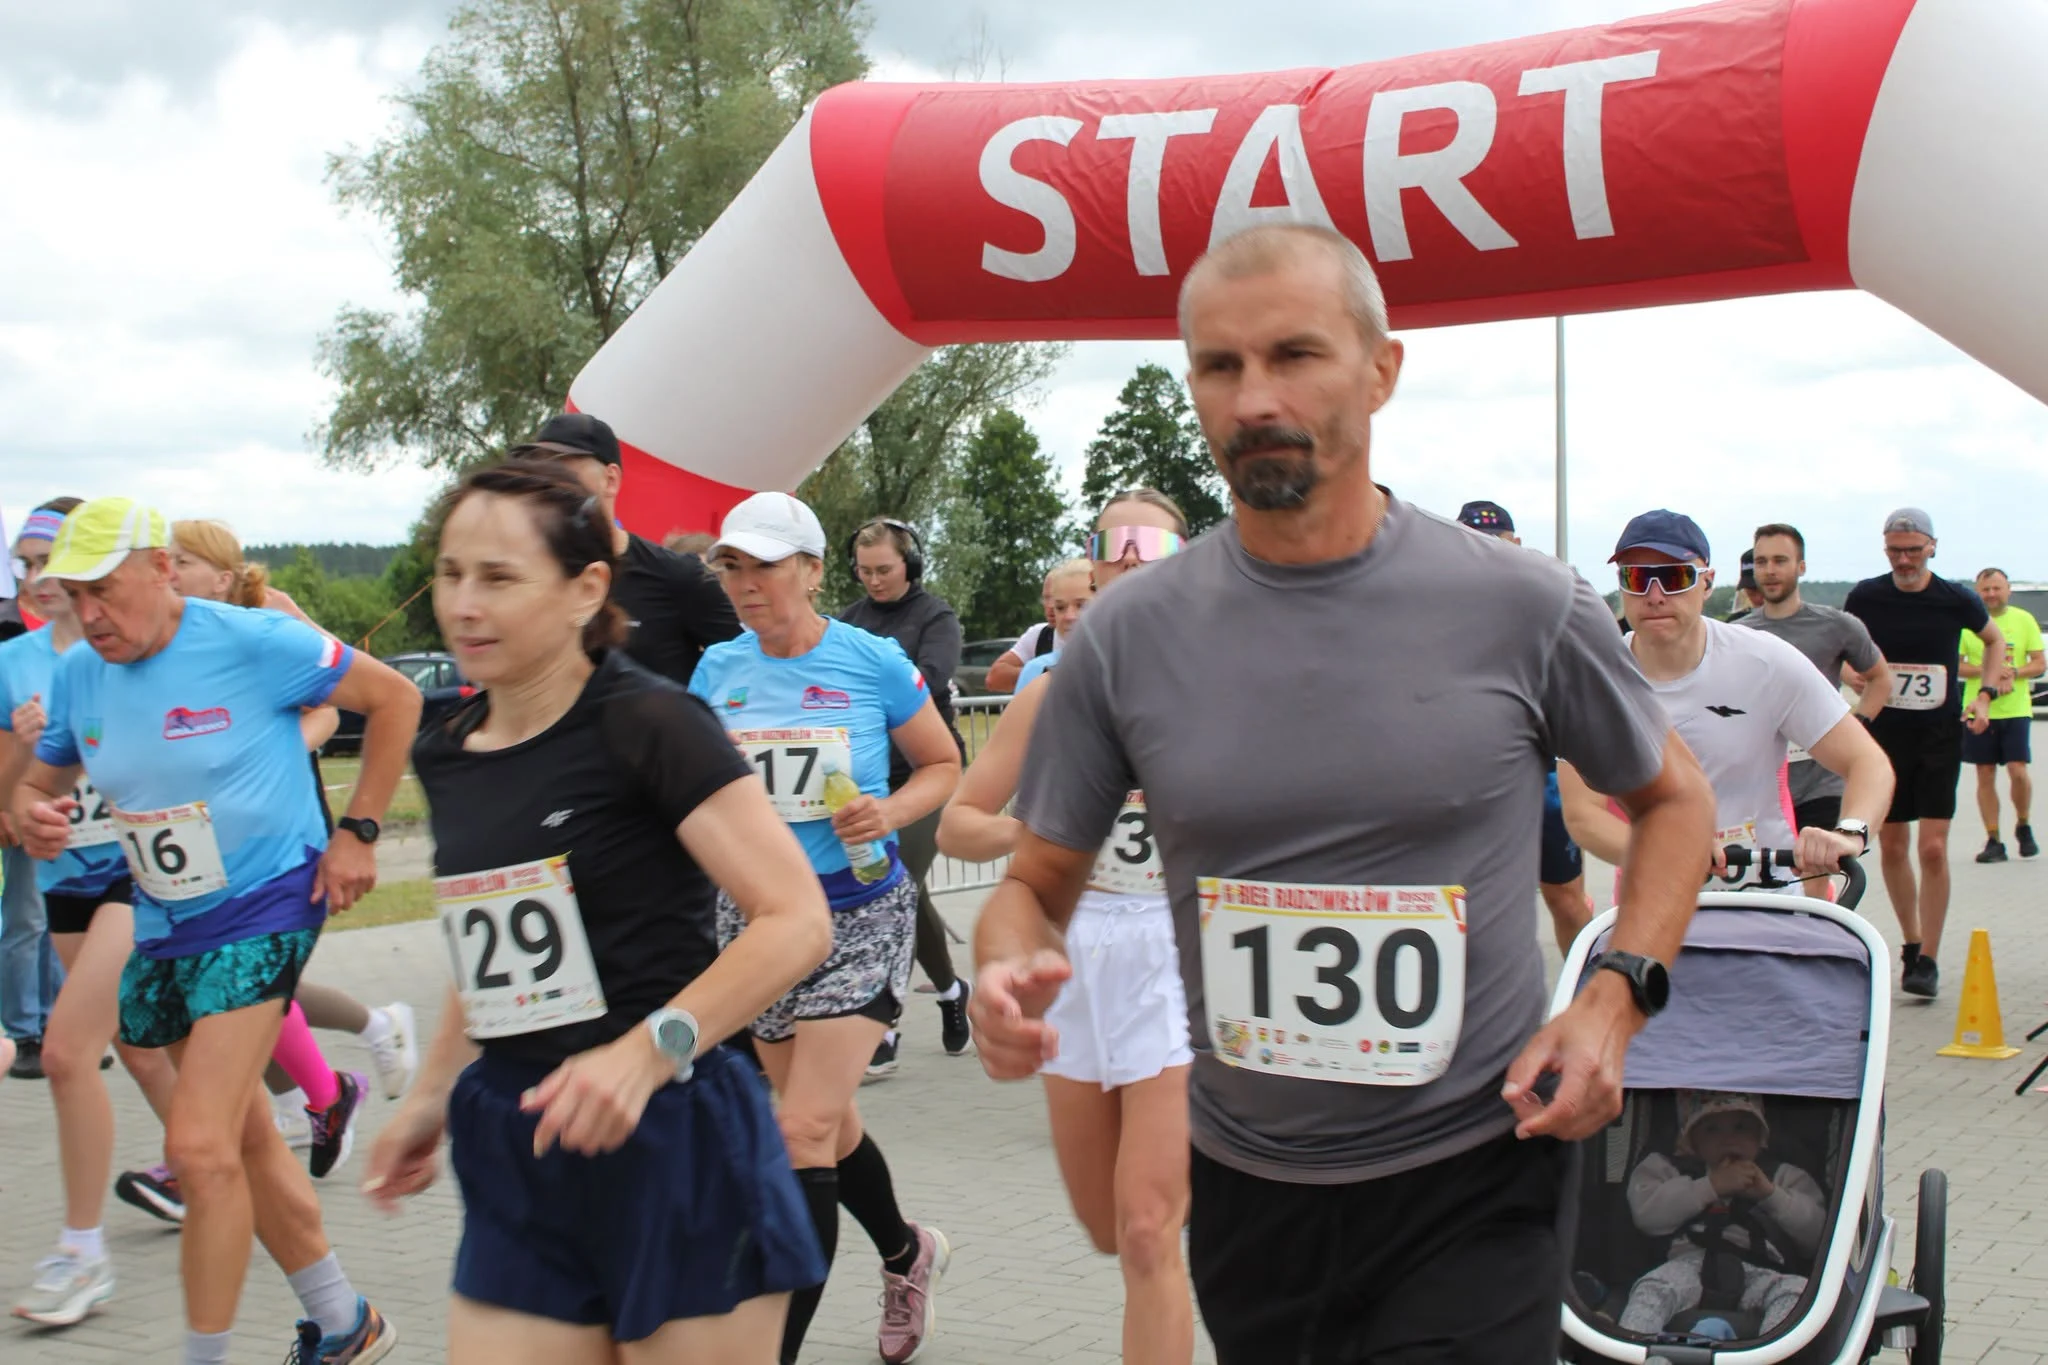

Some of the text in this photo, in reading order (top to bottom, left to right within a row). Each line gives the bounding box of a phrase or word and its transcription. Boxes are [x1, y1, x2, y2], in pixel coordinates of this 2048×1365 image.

[977, 48, 1660, 283] START
[1896, 673, 1932, 697] 73
[755, 747, 819, 796] 17
[126, 828, 187, 876] 16
[1231, 924, 1440, 1030] 130
